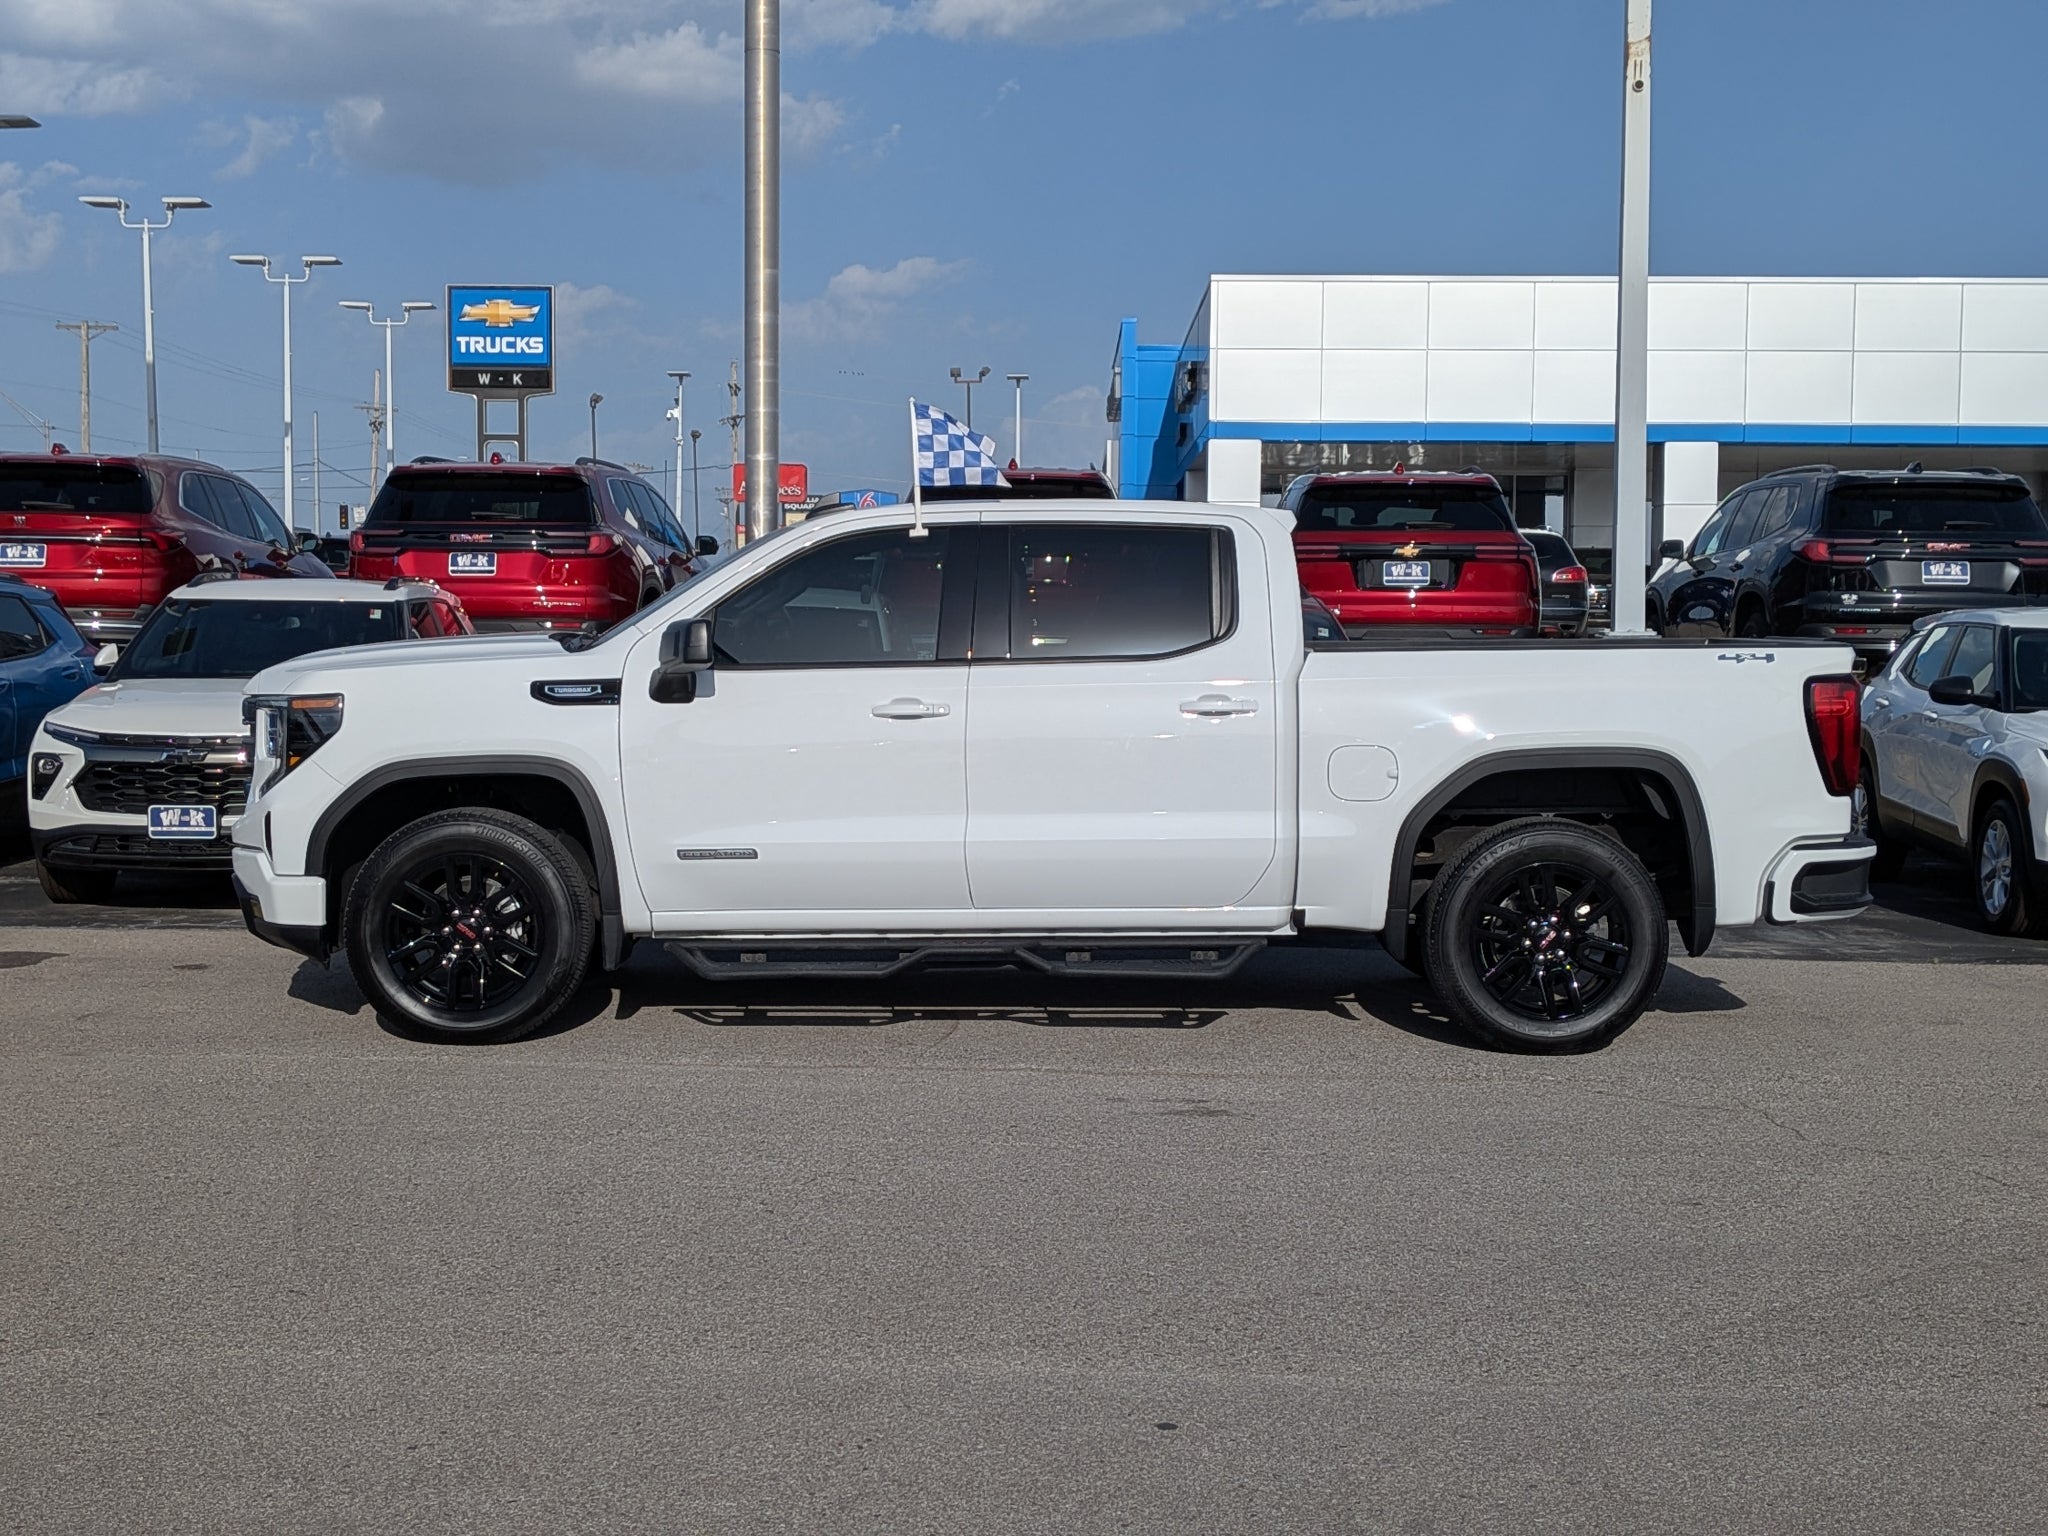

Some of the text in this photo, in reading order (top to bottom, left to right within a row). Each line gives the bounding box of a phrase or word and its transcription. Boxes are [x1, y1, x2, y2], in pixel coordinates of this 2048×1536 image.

[456, 336, 544, 354] TRUCKS
[858, 491, 878, 509] 6
[6, 546, 39, 559] W-K
[457, 553, 489, 567] W-K
[1391, 563, 1423, 577] W-K
[1929, 562, 1962, 576] W-K
[159, 808, 207, 827] W-K
[474, 825, 549, 873] BRIDGESTONE
